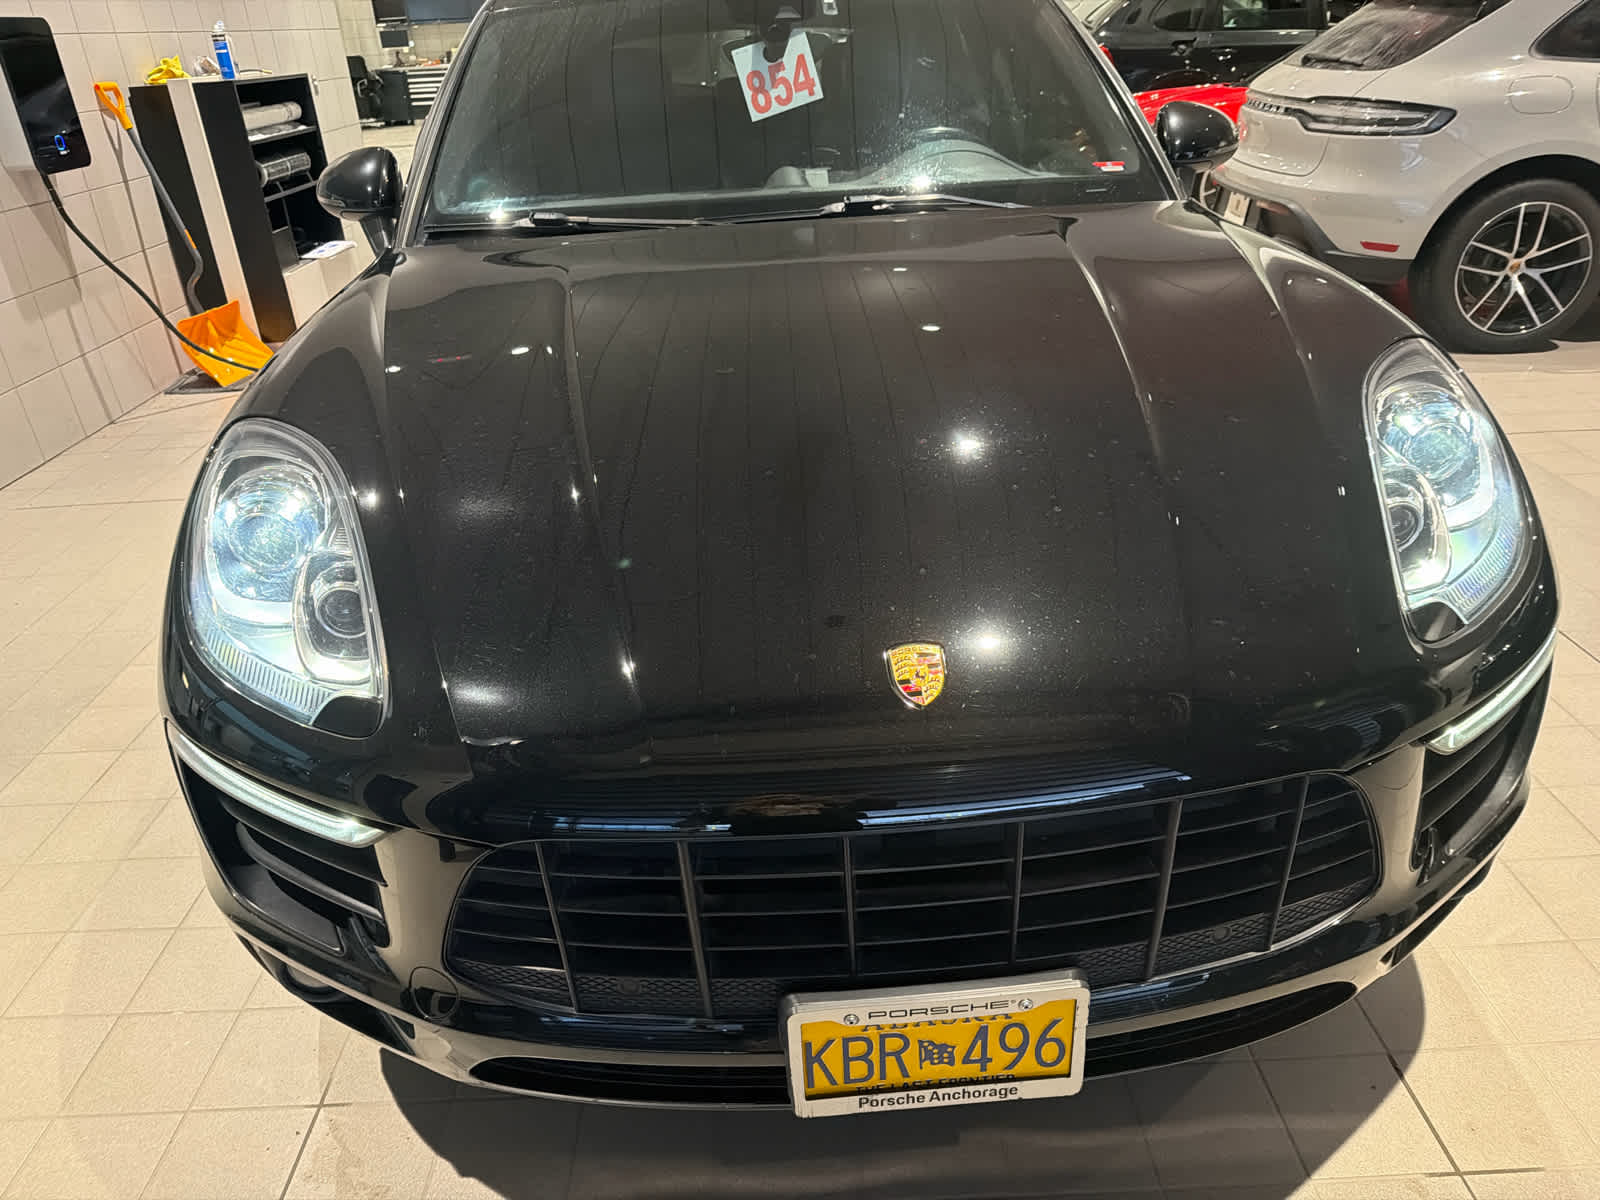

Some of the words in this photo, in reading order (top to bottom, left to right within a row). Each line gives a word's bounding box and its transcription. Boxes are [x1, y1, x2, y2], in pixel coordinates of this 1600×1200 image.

[746, 53, 816, 114] 854
[868, 1000, 1009, 1019] PORSCHE
[805, 1031, 910, 1089] KBR
[961, 1018, 1066, 1072] 496
[858, 1093, 925, 1108] Porsche
[929, 1086, 1018, 1102] Anchorage
